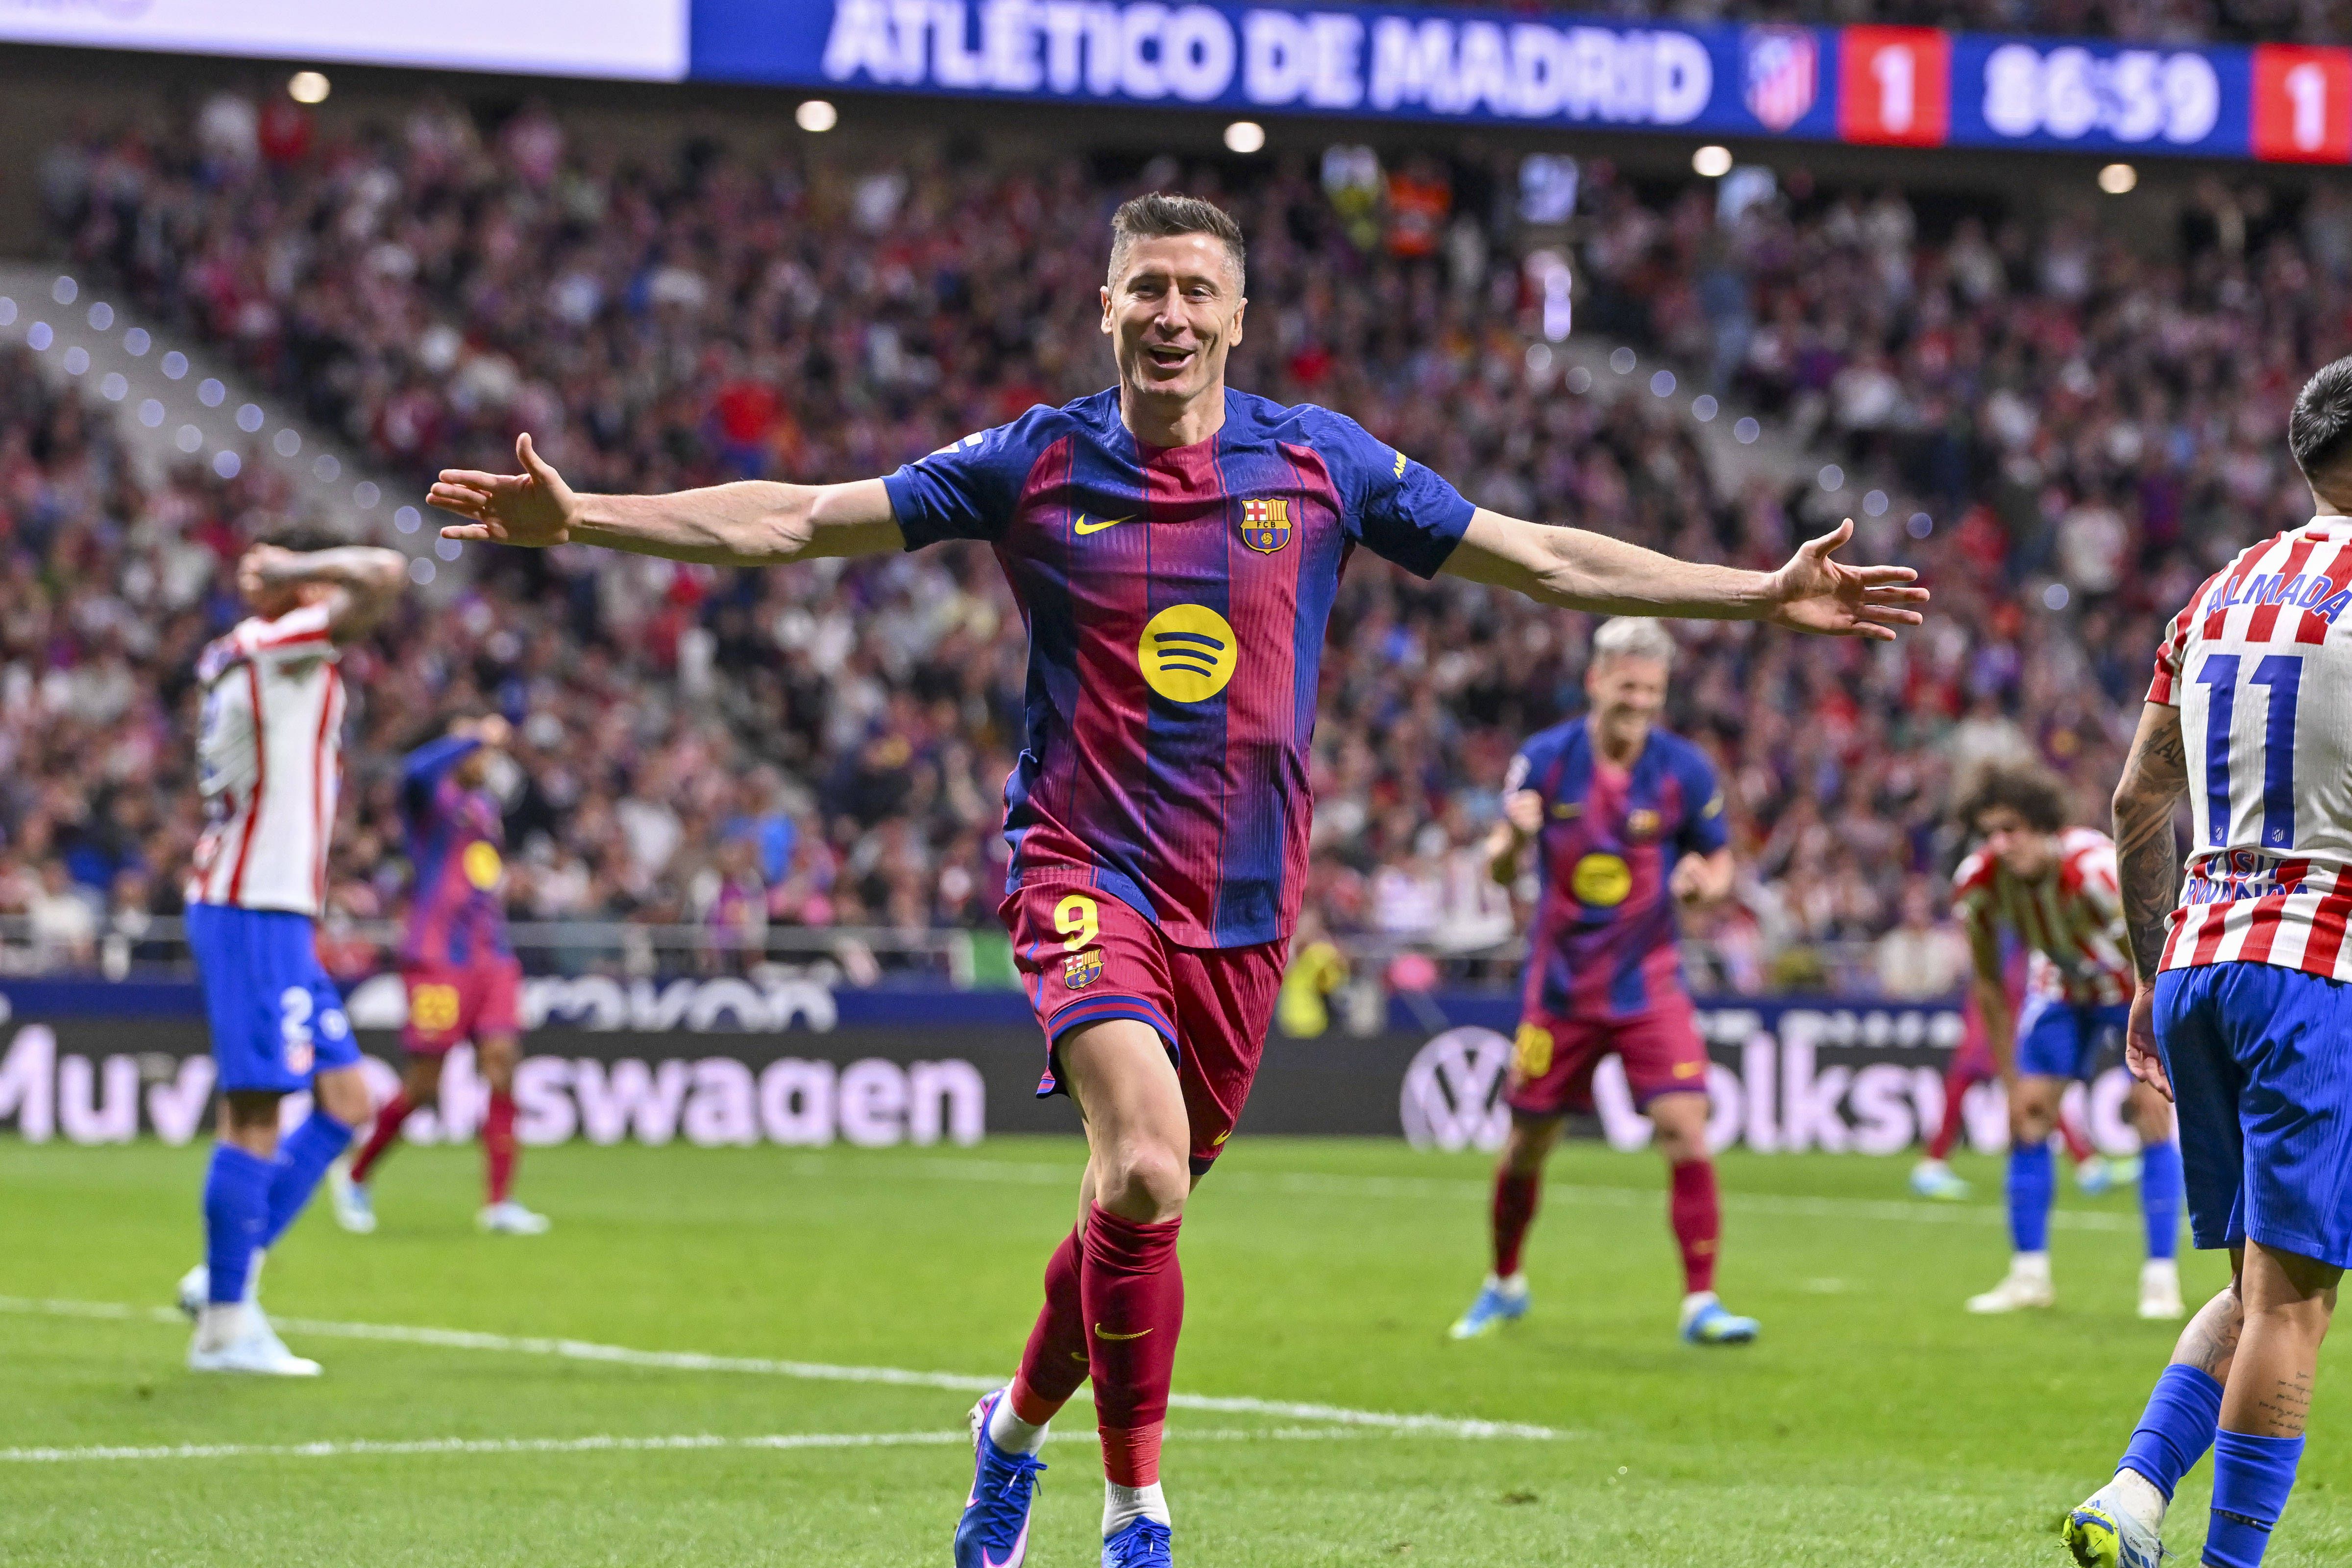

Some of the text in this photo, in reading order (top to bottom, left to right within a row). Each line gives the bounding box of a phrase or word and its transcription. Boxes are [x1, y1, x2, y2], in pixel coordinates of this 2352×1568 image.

[1245, 7, 1365, 108] DE
[1373, 17, 1713, 125] MADRID
[1872, 42, 1916, 134] 1
[2283, 62, 2327, 152] 1
[2205, 572, 2352, 625] ALMADA
[2196, 654, 2303, 850] 11
[2205, 852, 2287, 879] VISIT
[1054, 894, 1099, 951] 9
[280, 985, 314, 1042] 2
